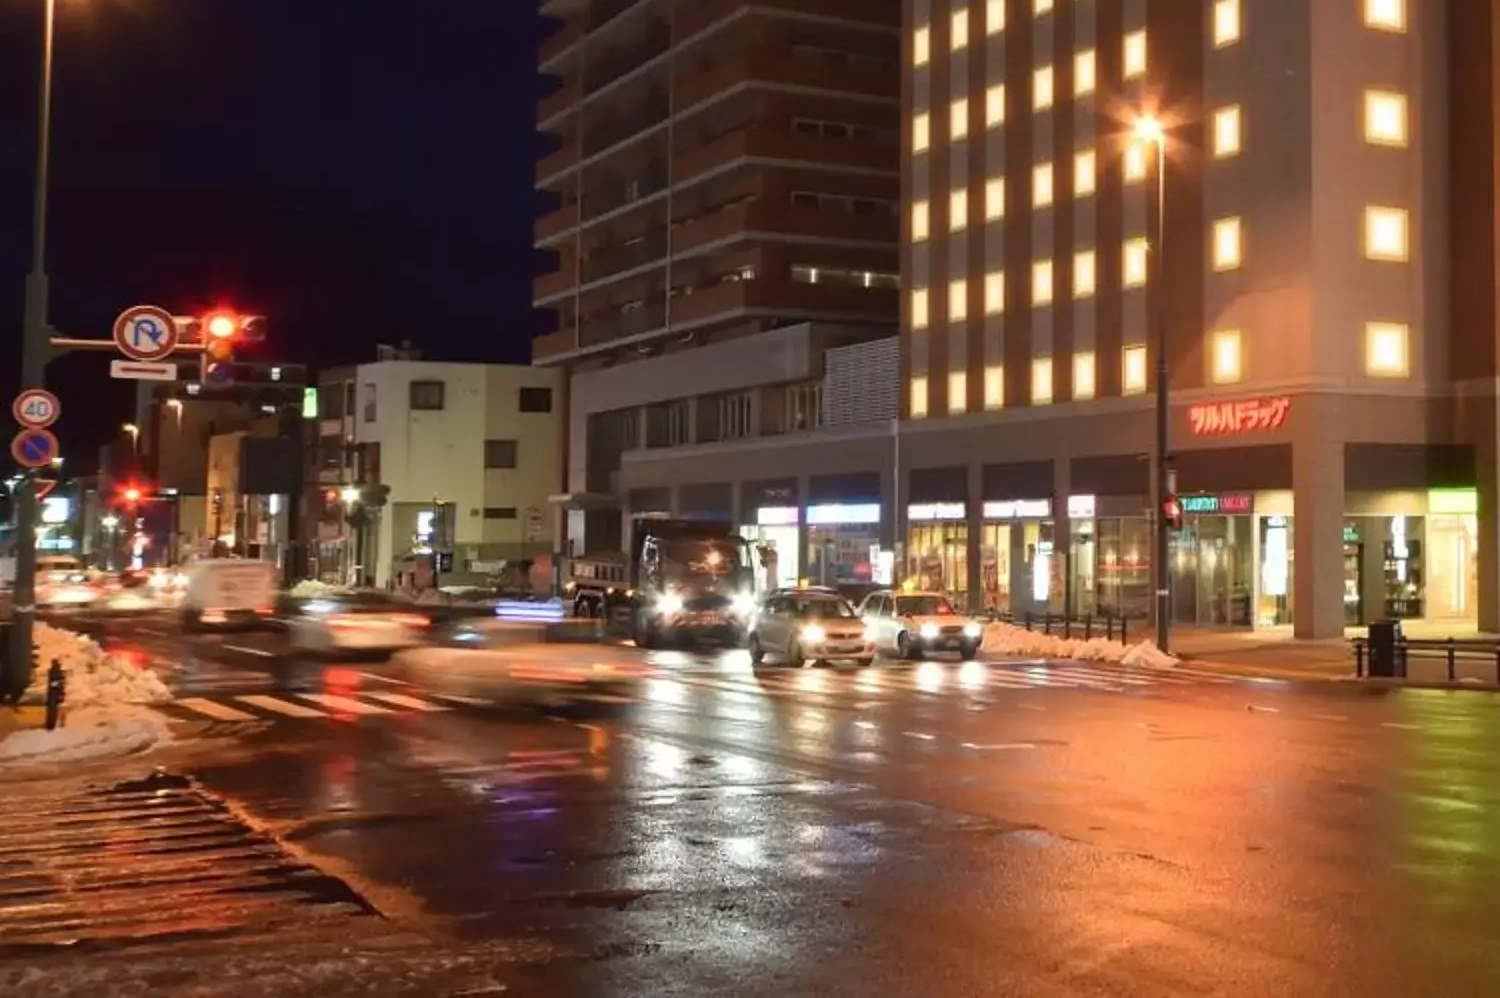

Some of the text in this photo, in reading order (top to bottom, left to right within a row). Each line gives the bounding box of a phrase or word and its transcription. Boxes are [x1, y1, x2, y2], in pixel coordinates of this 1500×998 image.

[24, 401, 47, 417] 40
[1189, 397, 1289, 434] ツルハドラッグ
